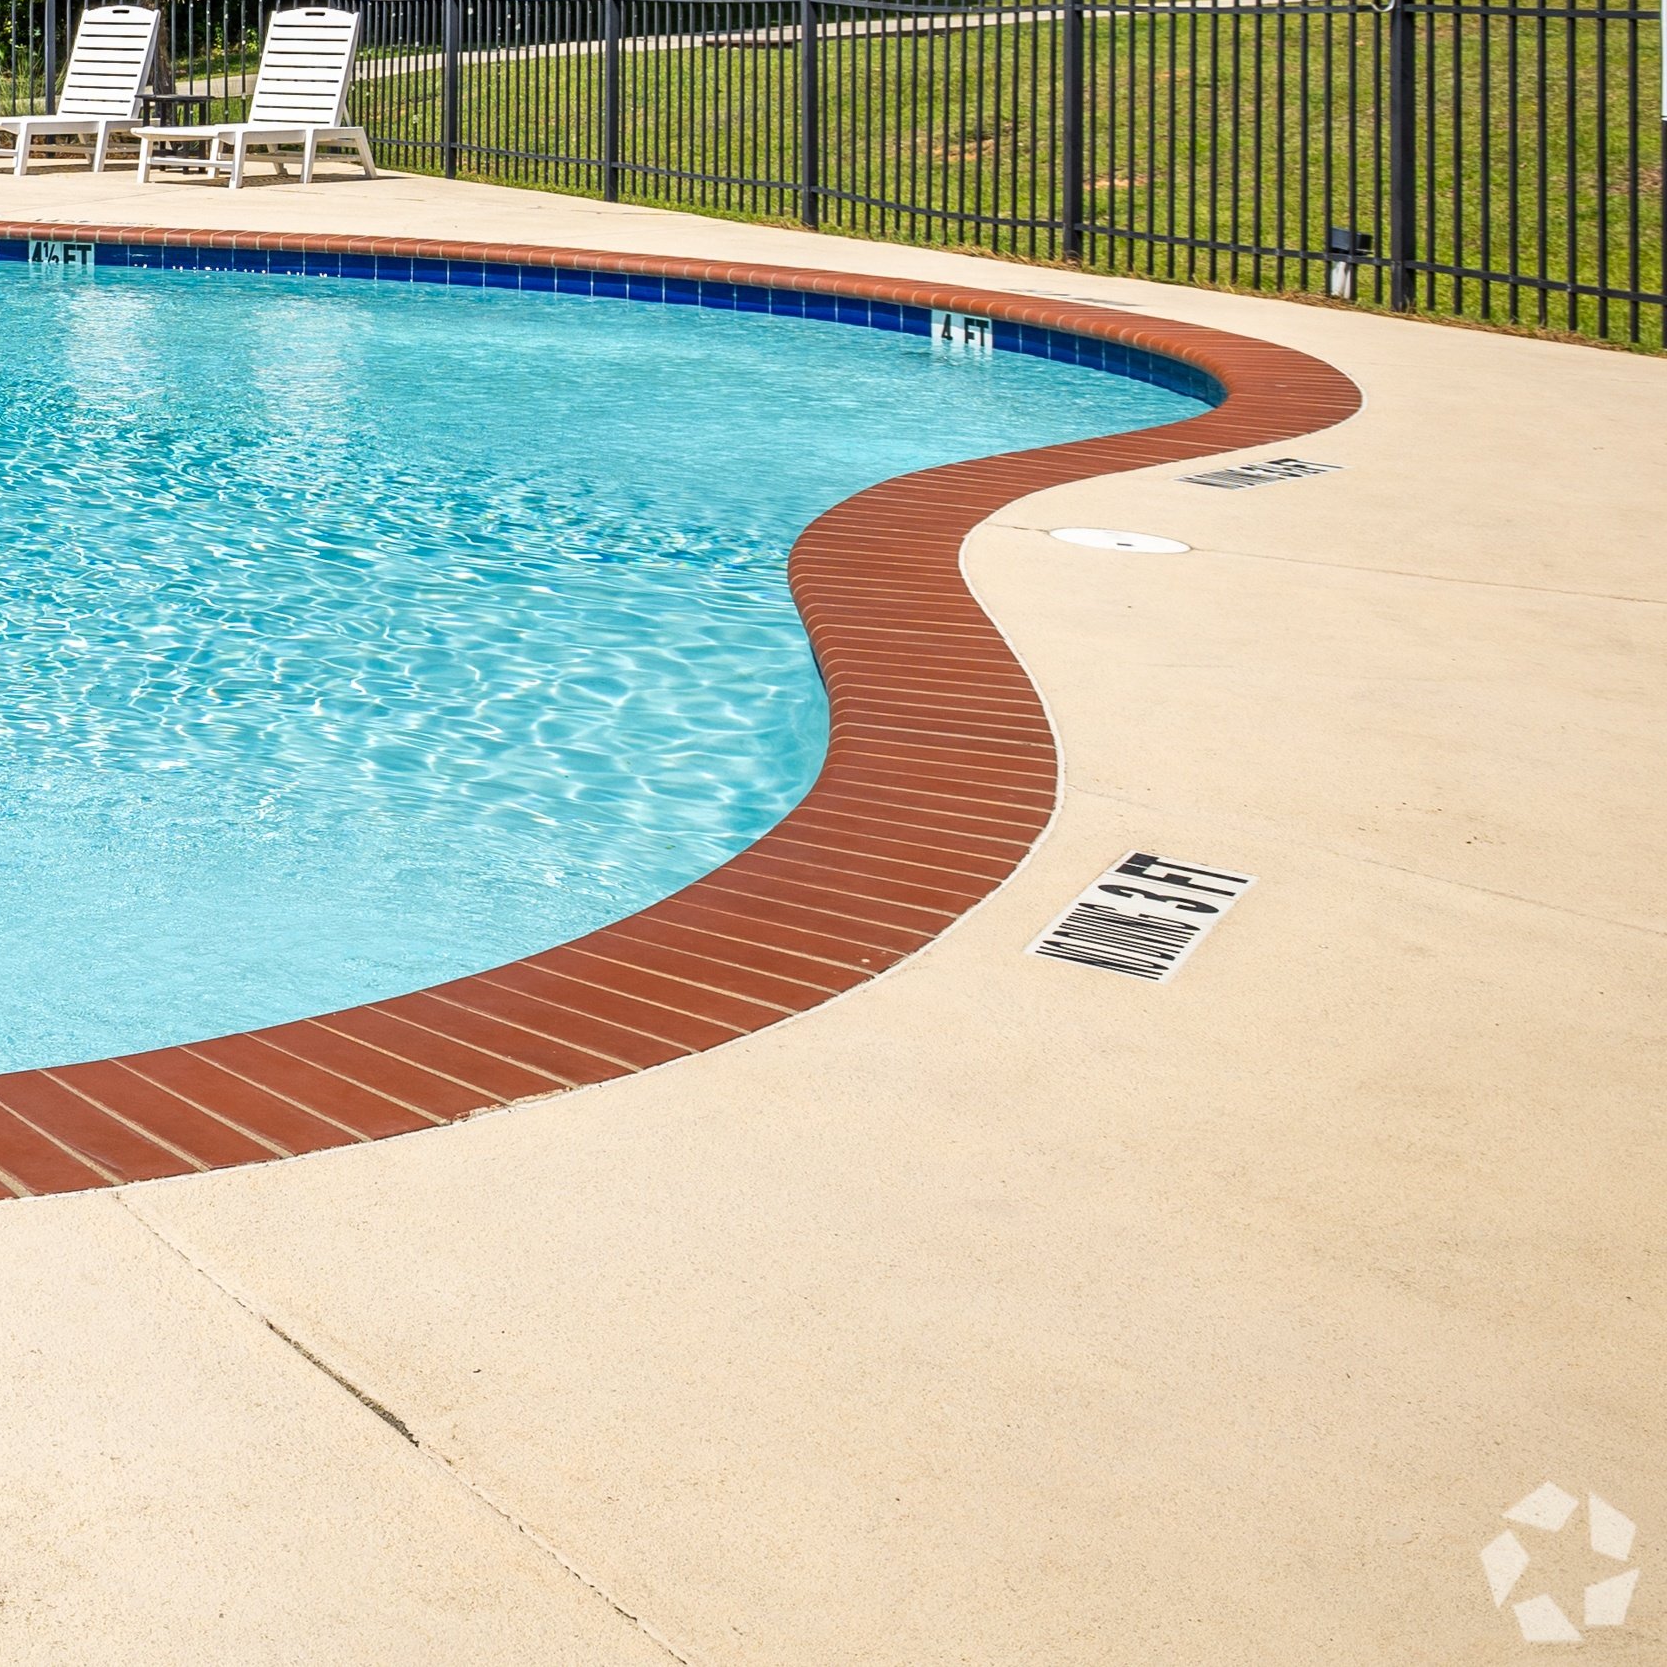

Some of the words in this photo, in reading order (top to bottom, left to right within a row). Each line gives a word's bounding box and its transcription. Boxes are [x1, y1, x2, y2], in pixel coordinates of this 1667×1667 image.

[63, 244, 92, 265] FT
[941, 313, 953, 340] 4
[964, 317, 989, 346] FT
[1115, 852, 1249, 897] FT
[1098, 884, 1219, 914] 3
[1052, 903, 1201, 961] DIVING
[1035, 940, 1169, 980] NO
